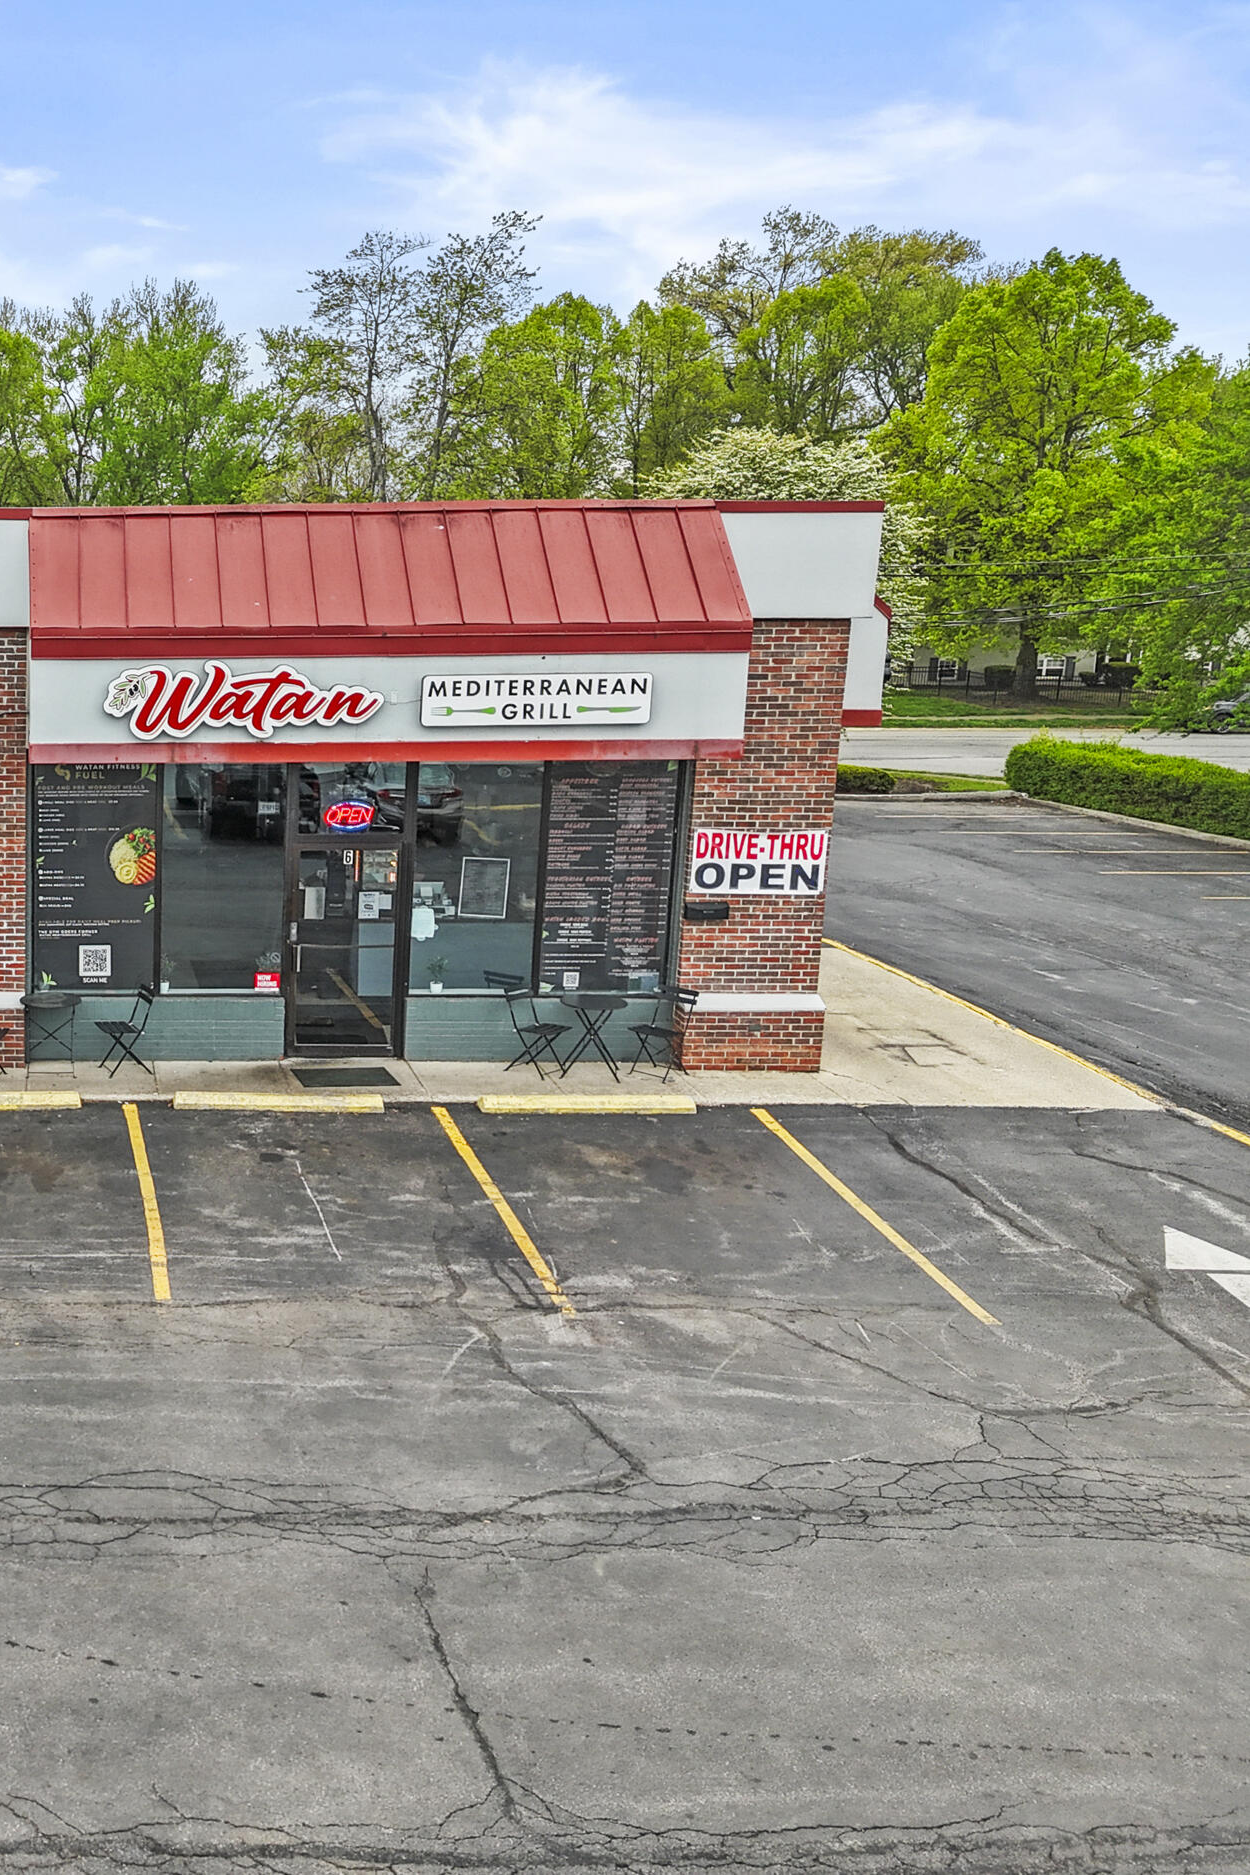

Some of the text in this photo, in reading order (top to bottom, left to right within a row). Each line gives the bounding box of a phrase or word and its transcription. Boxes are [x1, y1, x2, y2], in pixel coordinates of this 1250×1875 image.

[428, 678, 648, 698] MEDITERRANEAN
[135, 666, 379, 732] Watan
[501, 703, 571, 720] GRILL
[326, 806, 374, 824] OPEN
[696, 832, 824, 860] DRIVE-THRU
[344, 851, 352, 864] 6
[694, 862, 820, 890] OPEN
